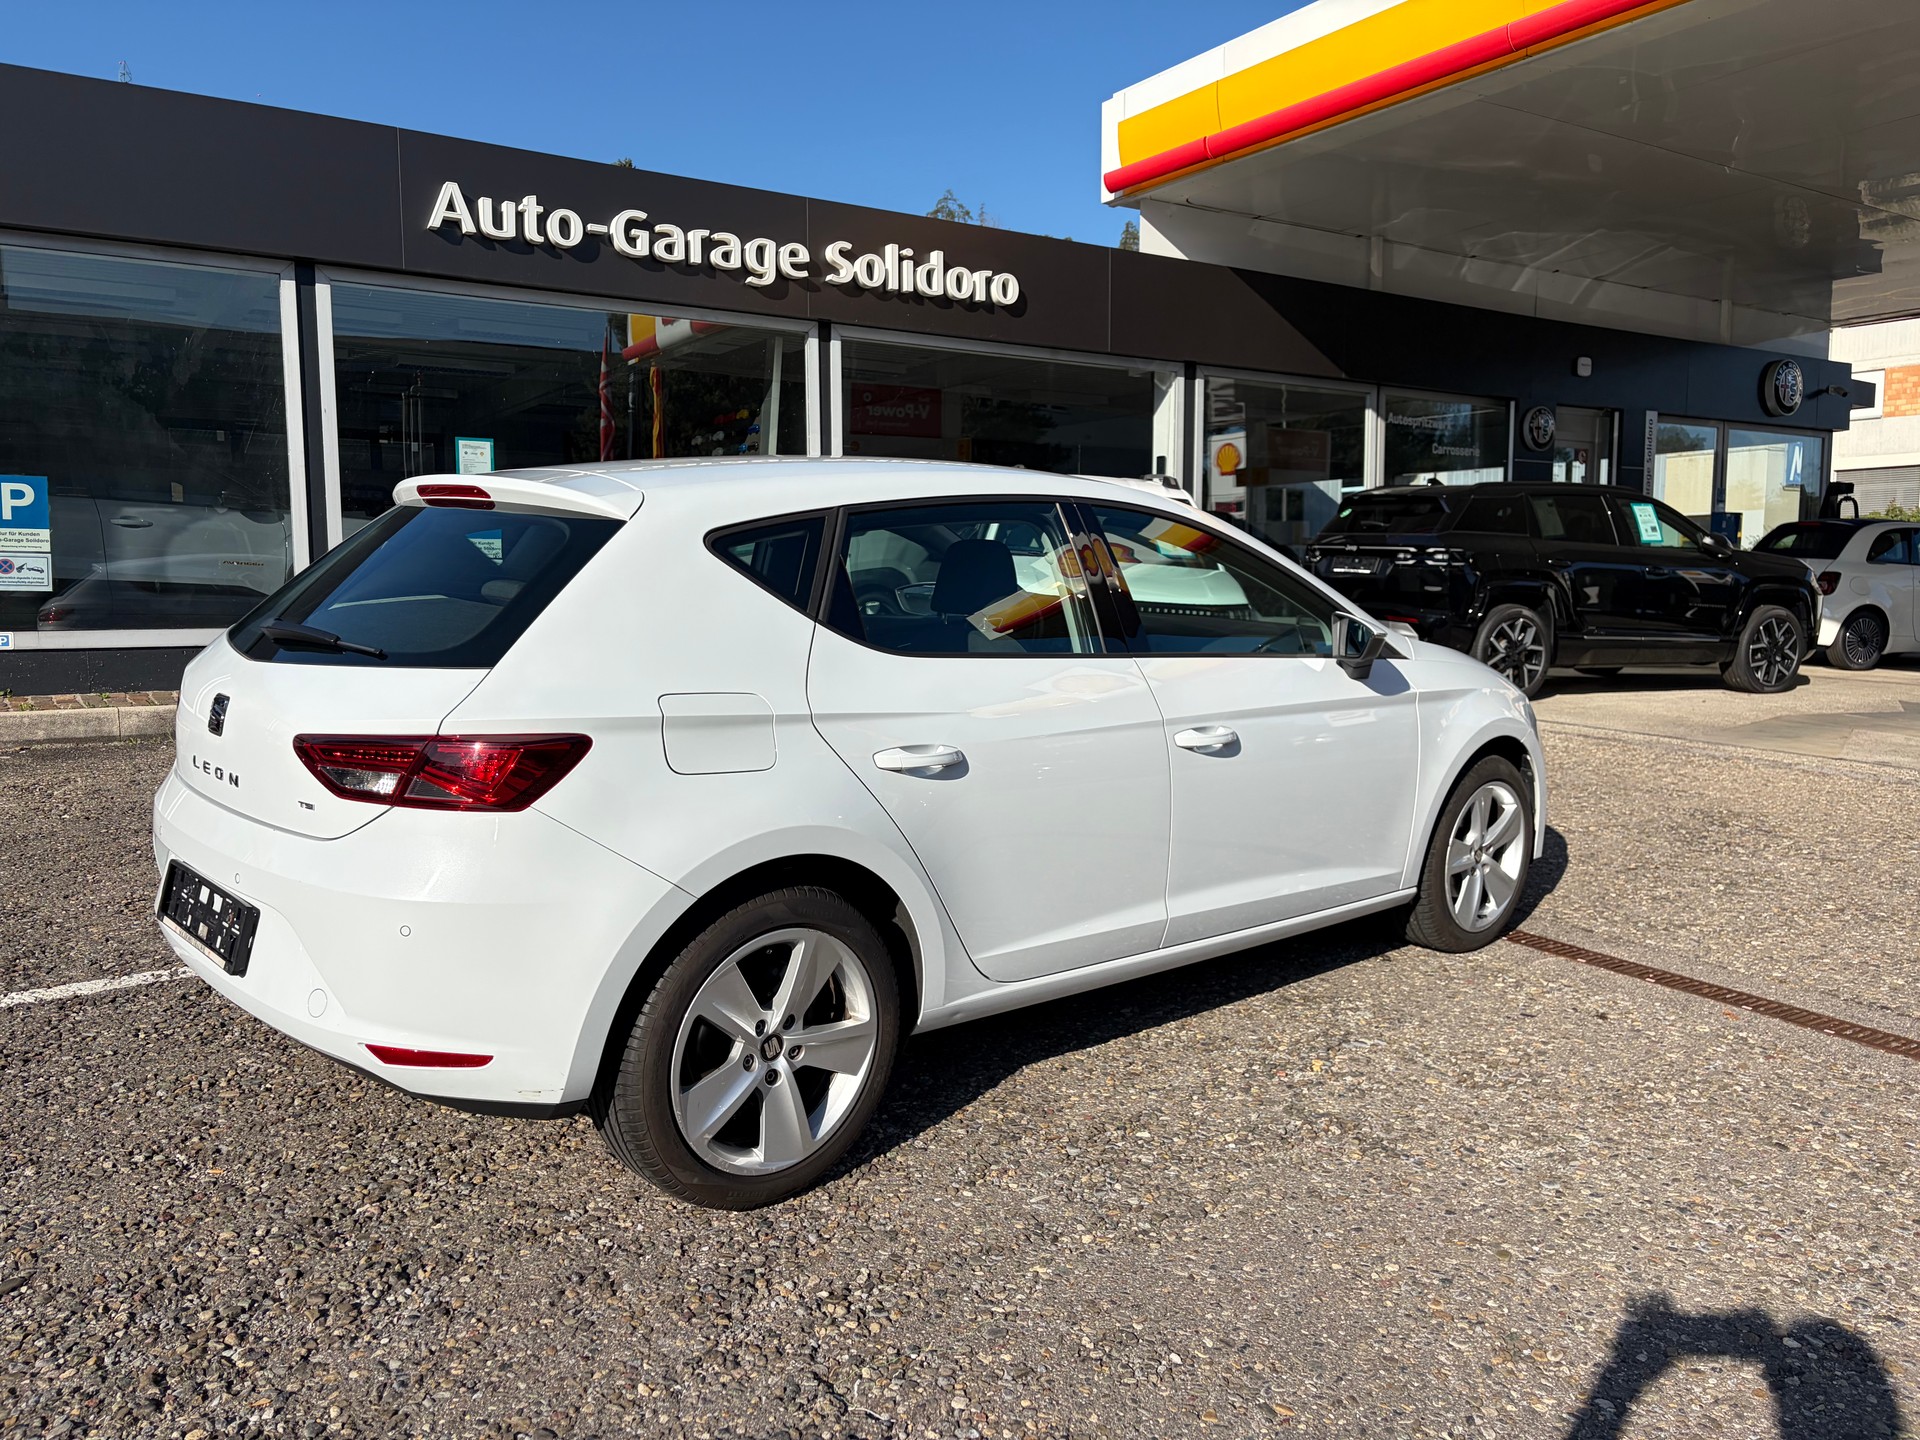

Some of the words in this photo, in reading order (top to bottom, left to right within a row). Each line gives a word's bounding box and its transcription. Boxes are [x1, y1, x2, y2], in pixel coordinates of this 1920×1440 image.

[427, 181, 810, 288] Auto-Garage
[825, 240, 1020, 305] Solidoro
[1432, 443, 1480, 457] Carrosserie
[1646, 418, 1654, 463] Solidoro
[1, 482, 35, 520] P
[192, 755, 239, 788] LEON
